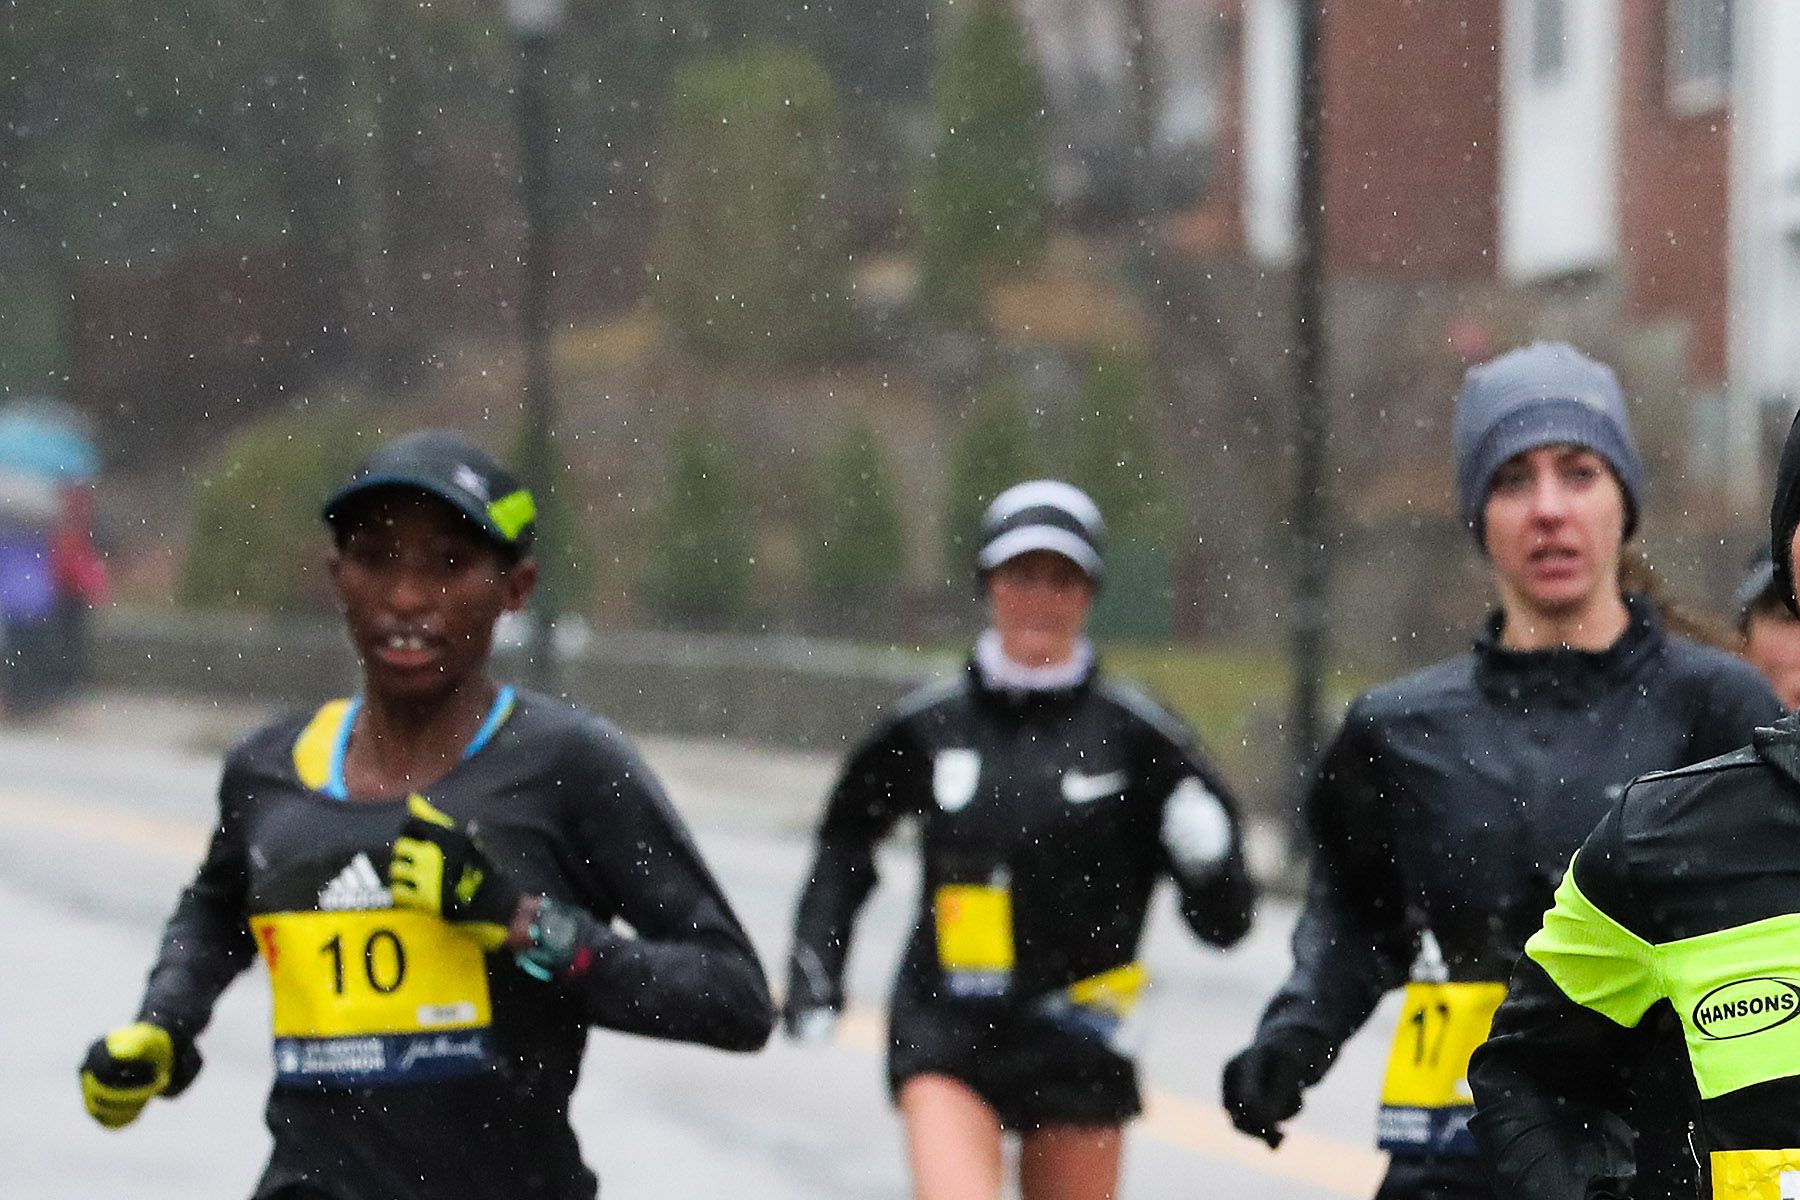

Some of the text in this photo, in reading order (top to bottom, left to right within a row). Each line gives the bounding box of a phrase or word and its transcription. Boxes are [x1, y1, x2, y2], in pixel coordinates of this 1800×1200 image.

[321, 929, 406, 994] 10
[1410, 1002, 1450, 1068] 17
[1701, 993, 1795, 1025] HANSONS
